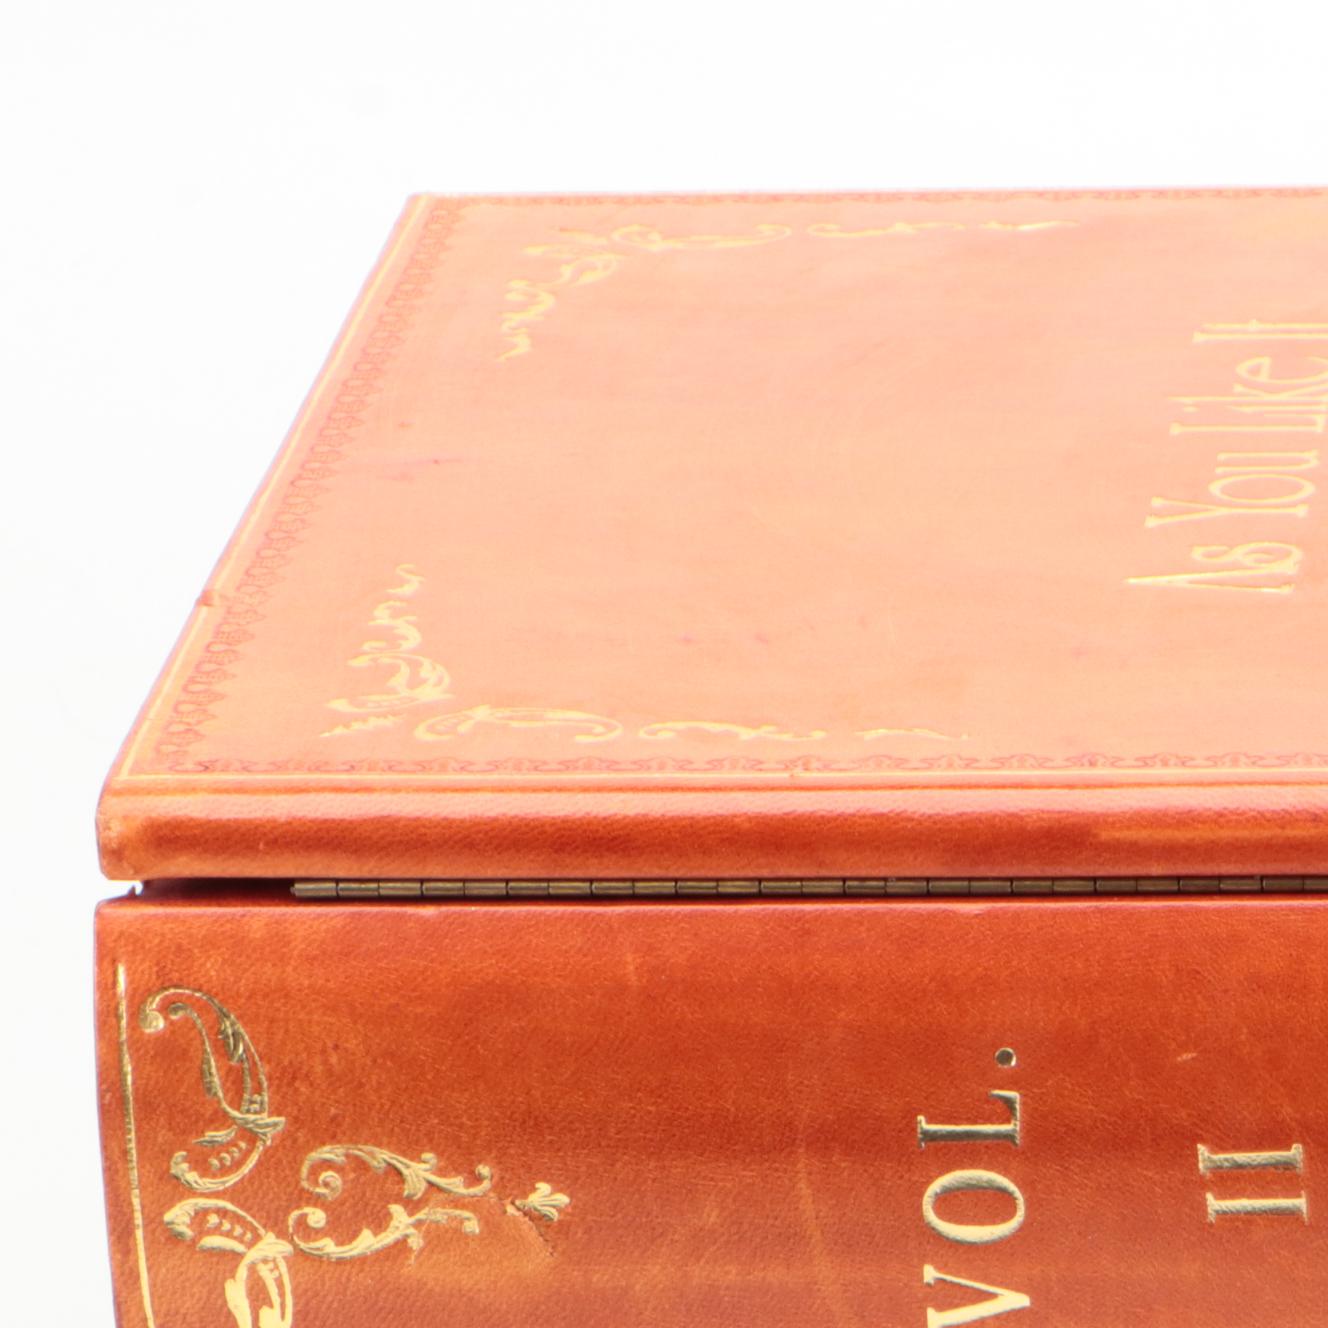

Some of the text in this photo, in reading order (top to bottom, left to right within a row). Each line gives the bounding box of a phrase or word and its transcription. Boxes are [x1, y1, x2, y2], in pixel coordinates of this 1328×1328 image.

[1144, 448, 1320, 528] You
[1126, 540, 1304, 593] As
[1197, 1143, 1310, 1225] II
